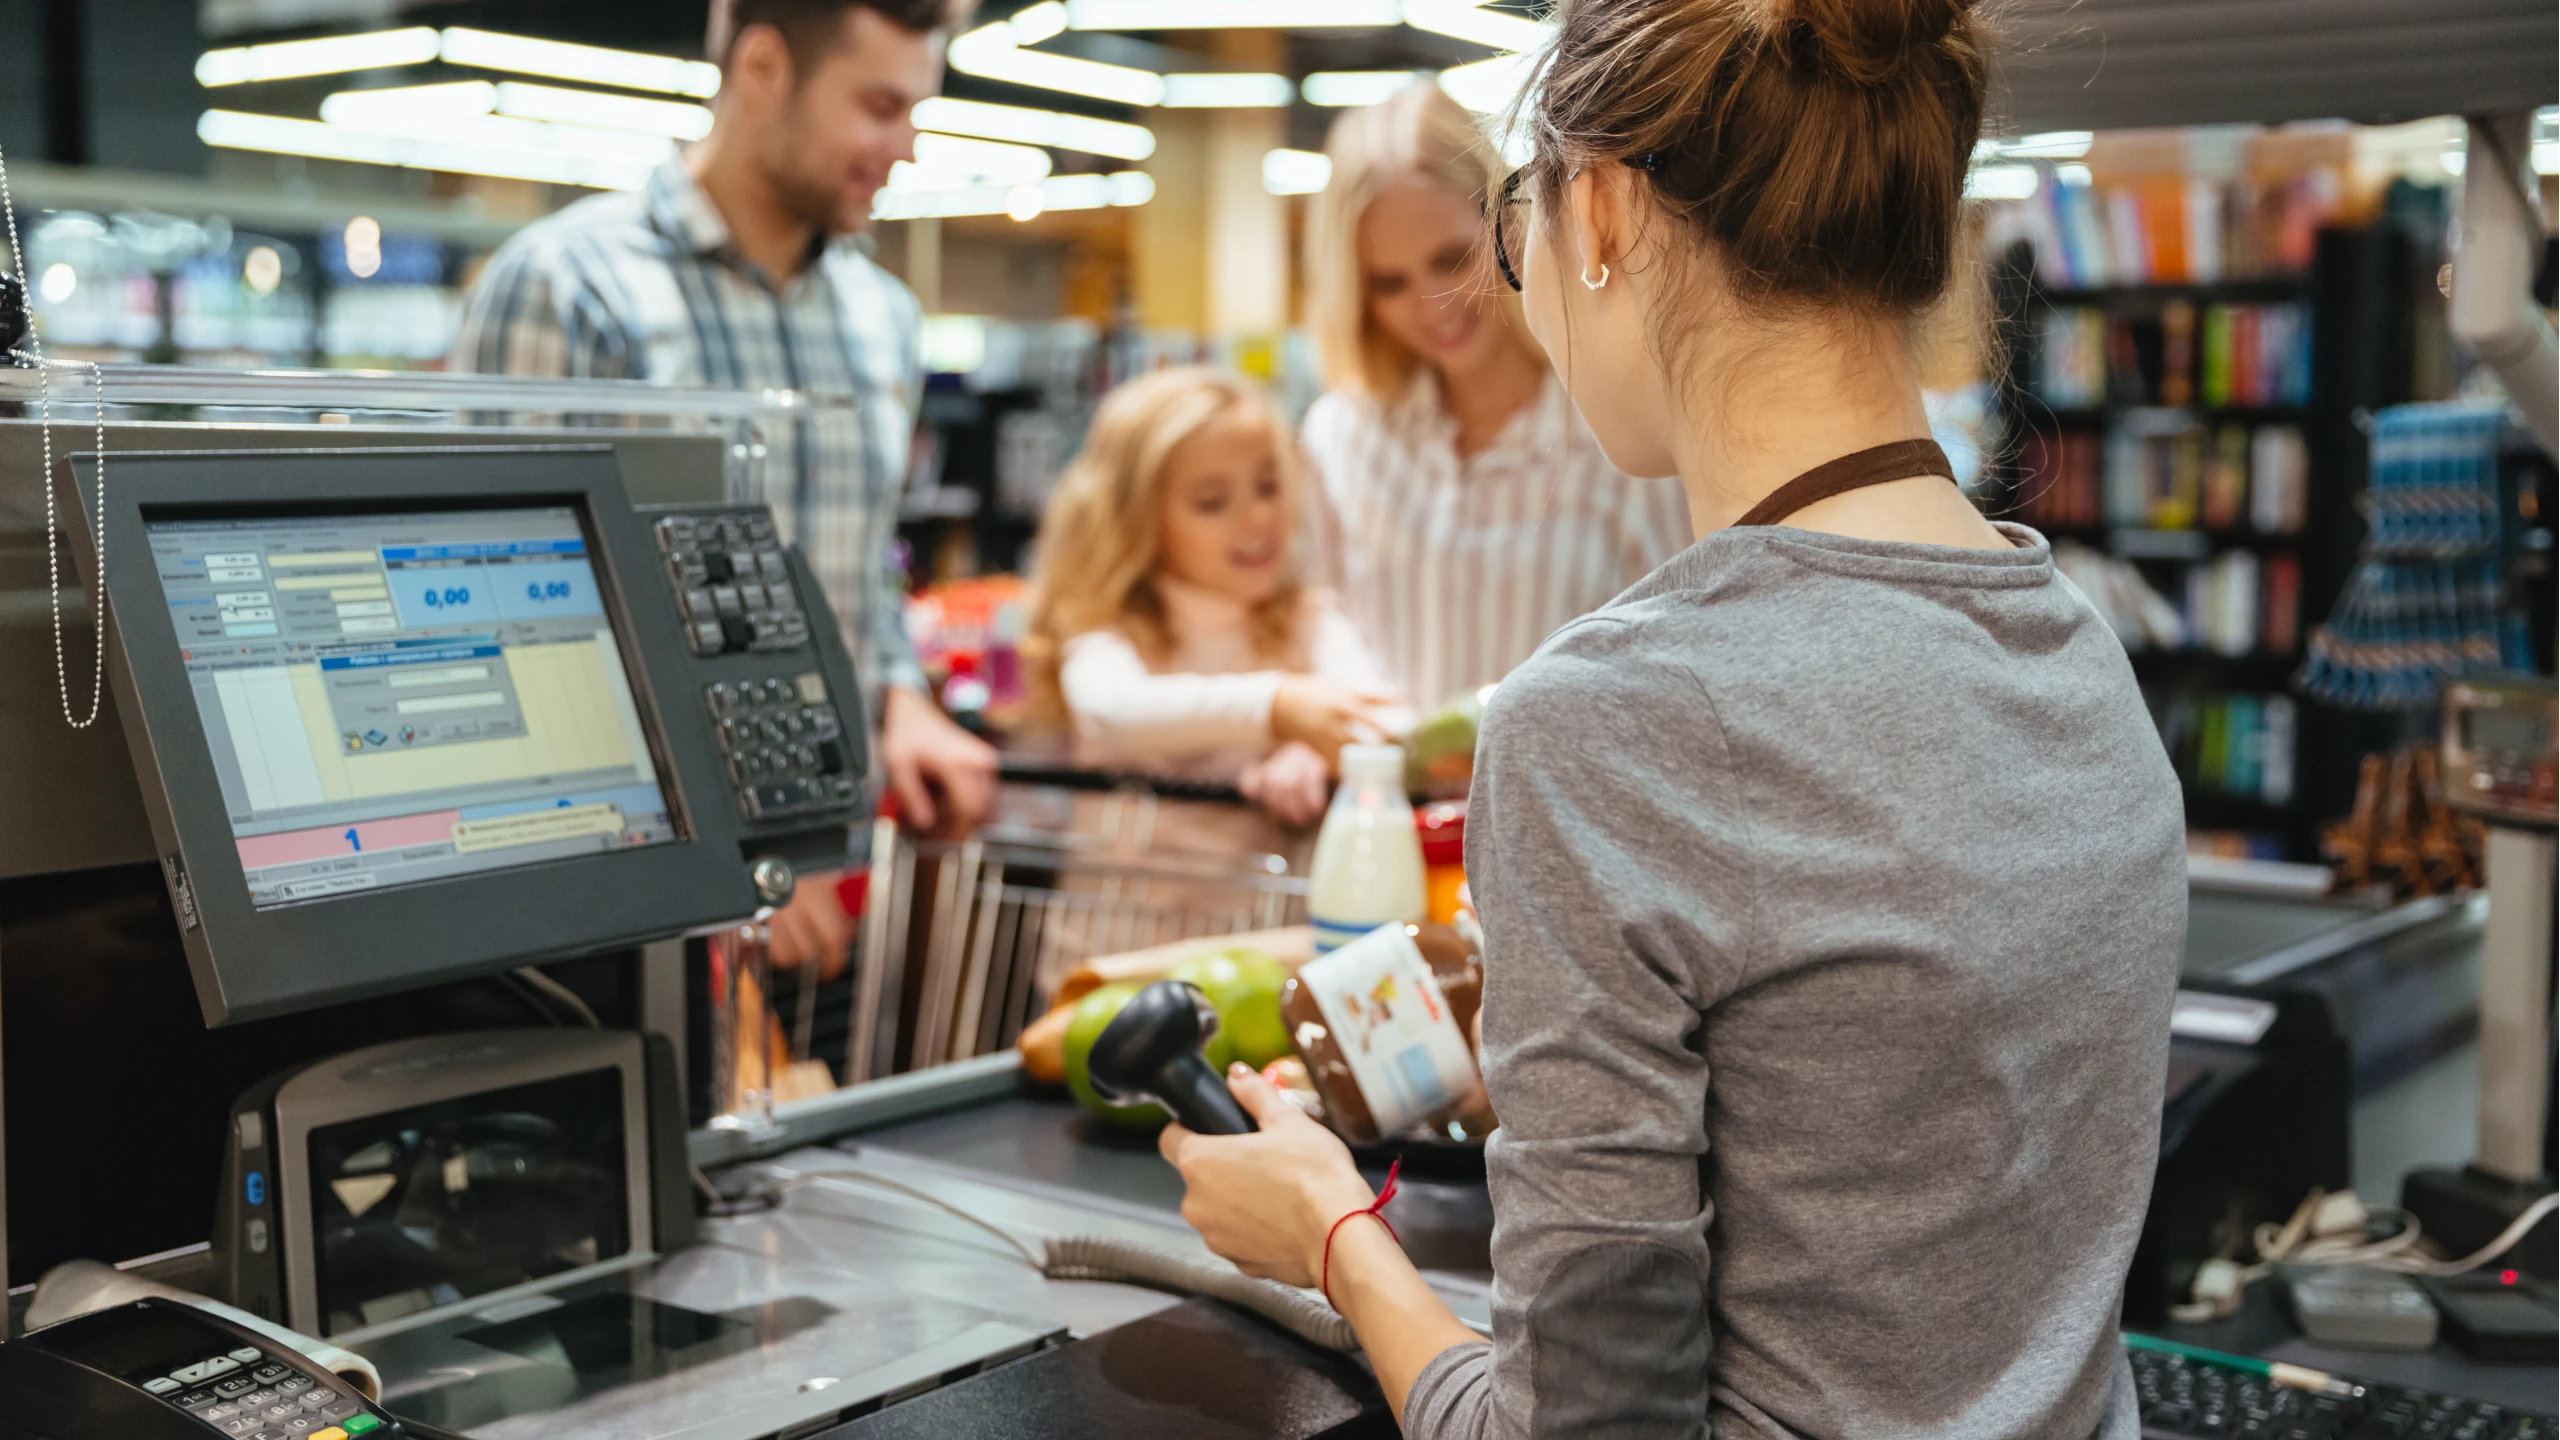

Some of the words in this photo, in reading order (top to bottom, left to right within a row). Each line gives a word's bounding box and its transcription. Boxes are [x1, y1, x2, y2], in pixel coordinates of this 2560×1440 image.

[528, 580, 571, 602] 0,00
[424, 587, 470, 609] 0,00
[344, 828, 361, 852] 1
[262, 1368, 276, 1376] 3
[224, 1382, 239, 1390] 2
[283, 1380, 298, 1389] 6
[183, 1396, 195, 1404] 1
[247, 1394, 261, 1402] 5
[306, 1392, 320, 1401] 9
[208, 1408, 221, 1419] 4
[270, 1406, 285, 1415] 8
[229, 1420, 242, 1429] 7
